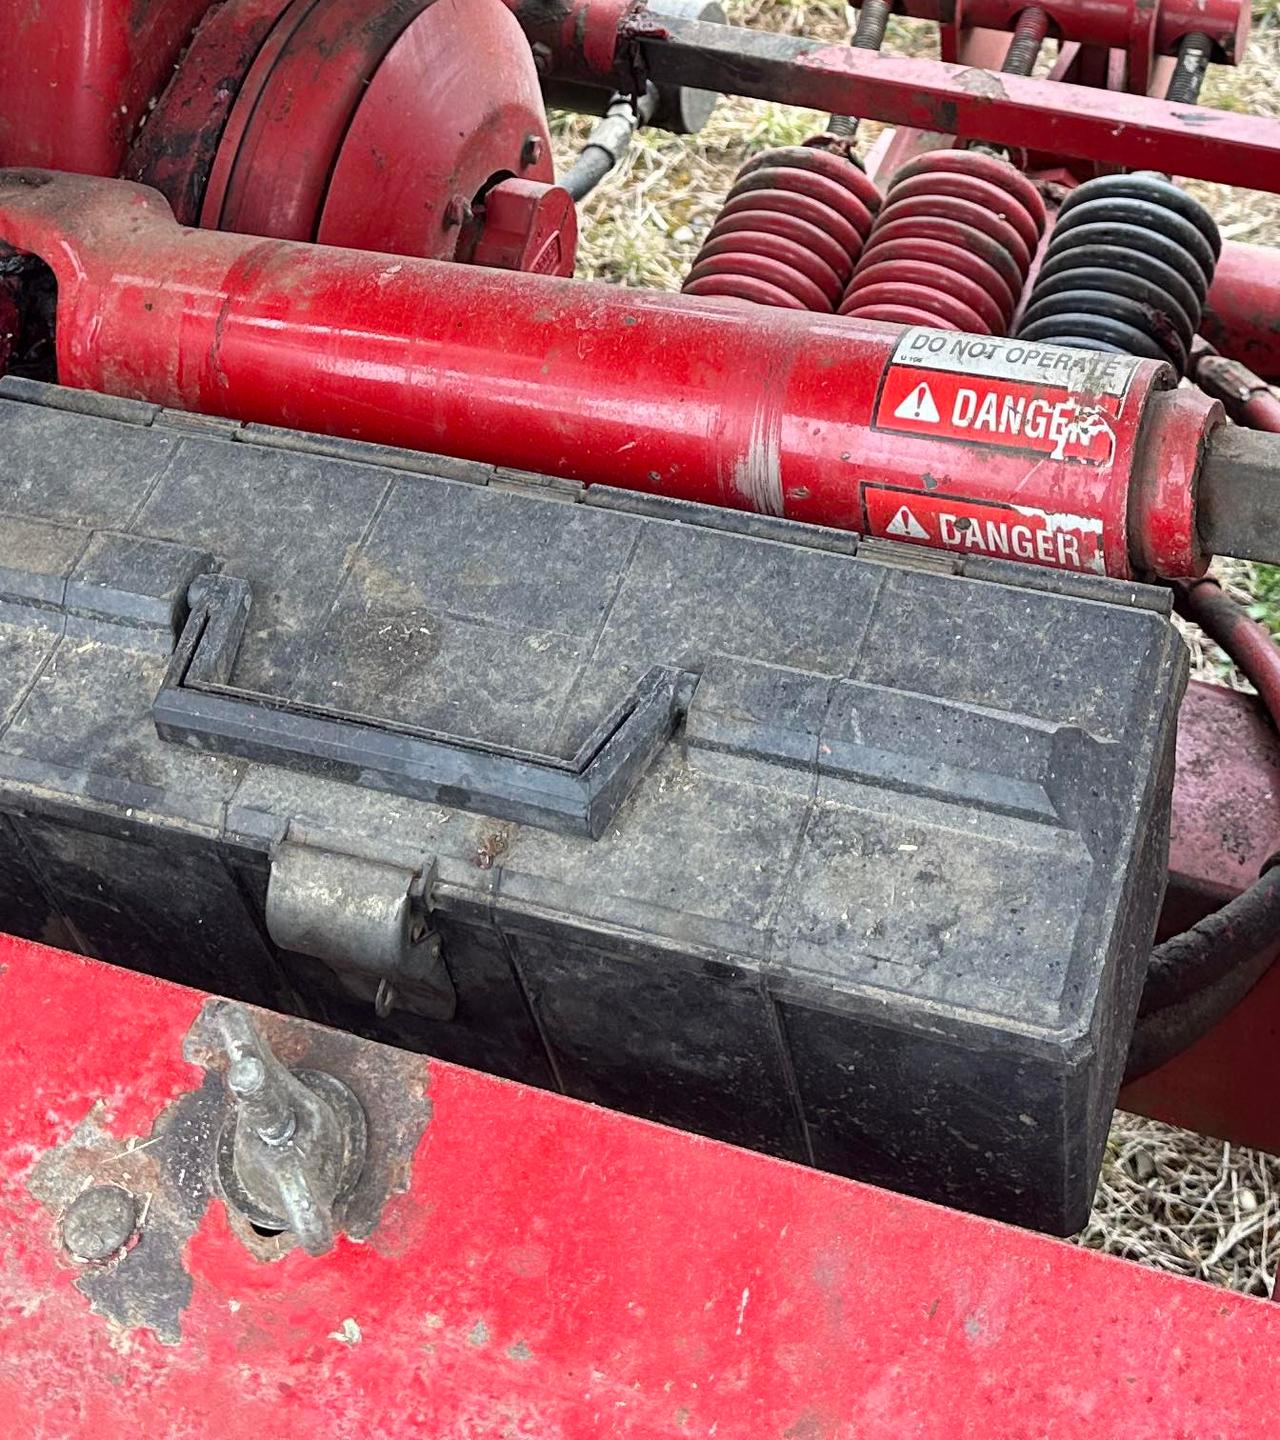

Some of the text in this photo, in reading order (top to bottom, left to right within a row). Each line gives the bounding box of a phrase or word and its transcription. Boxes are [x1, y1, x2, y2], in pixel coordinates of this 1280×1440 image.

[910, 333, 1121, 377] DO NOT OPERATE
[938, 512, 1081, 567] DANGER
